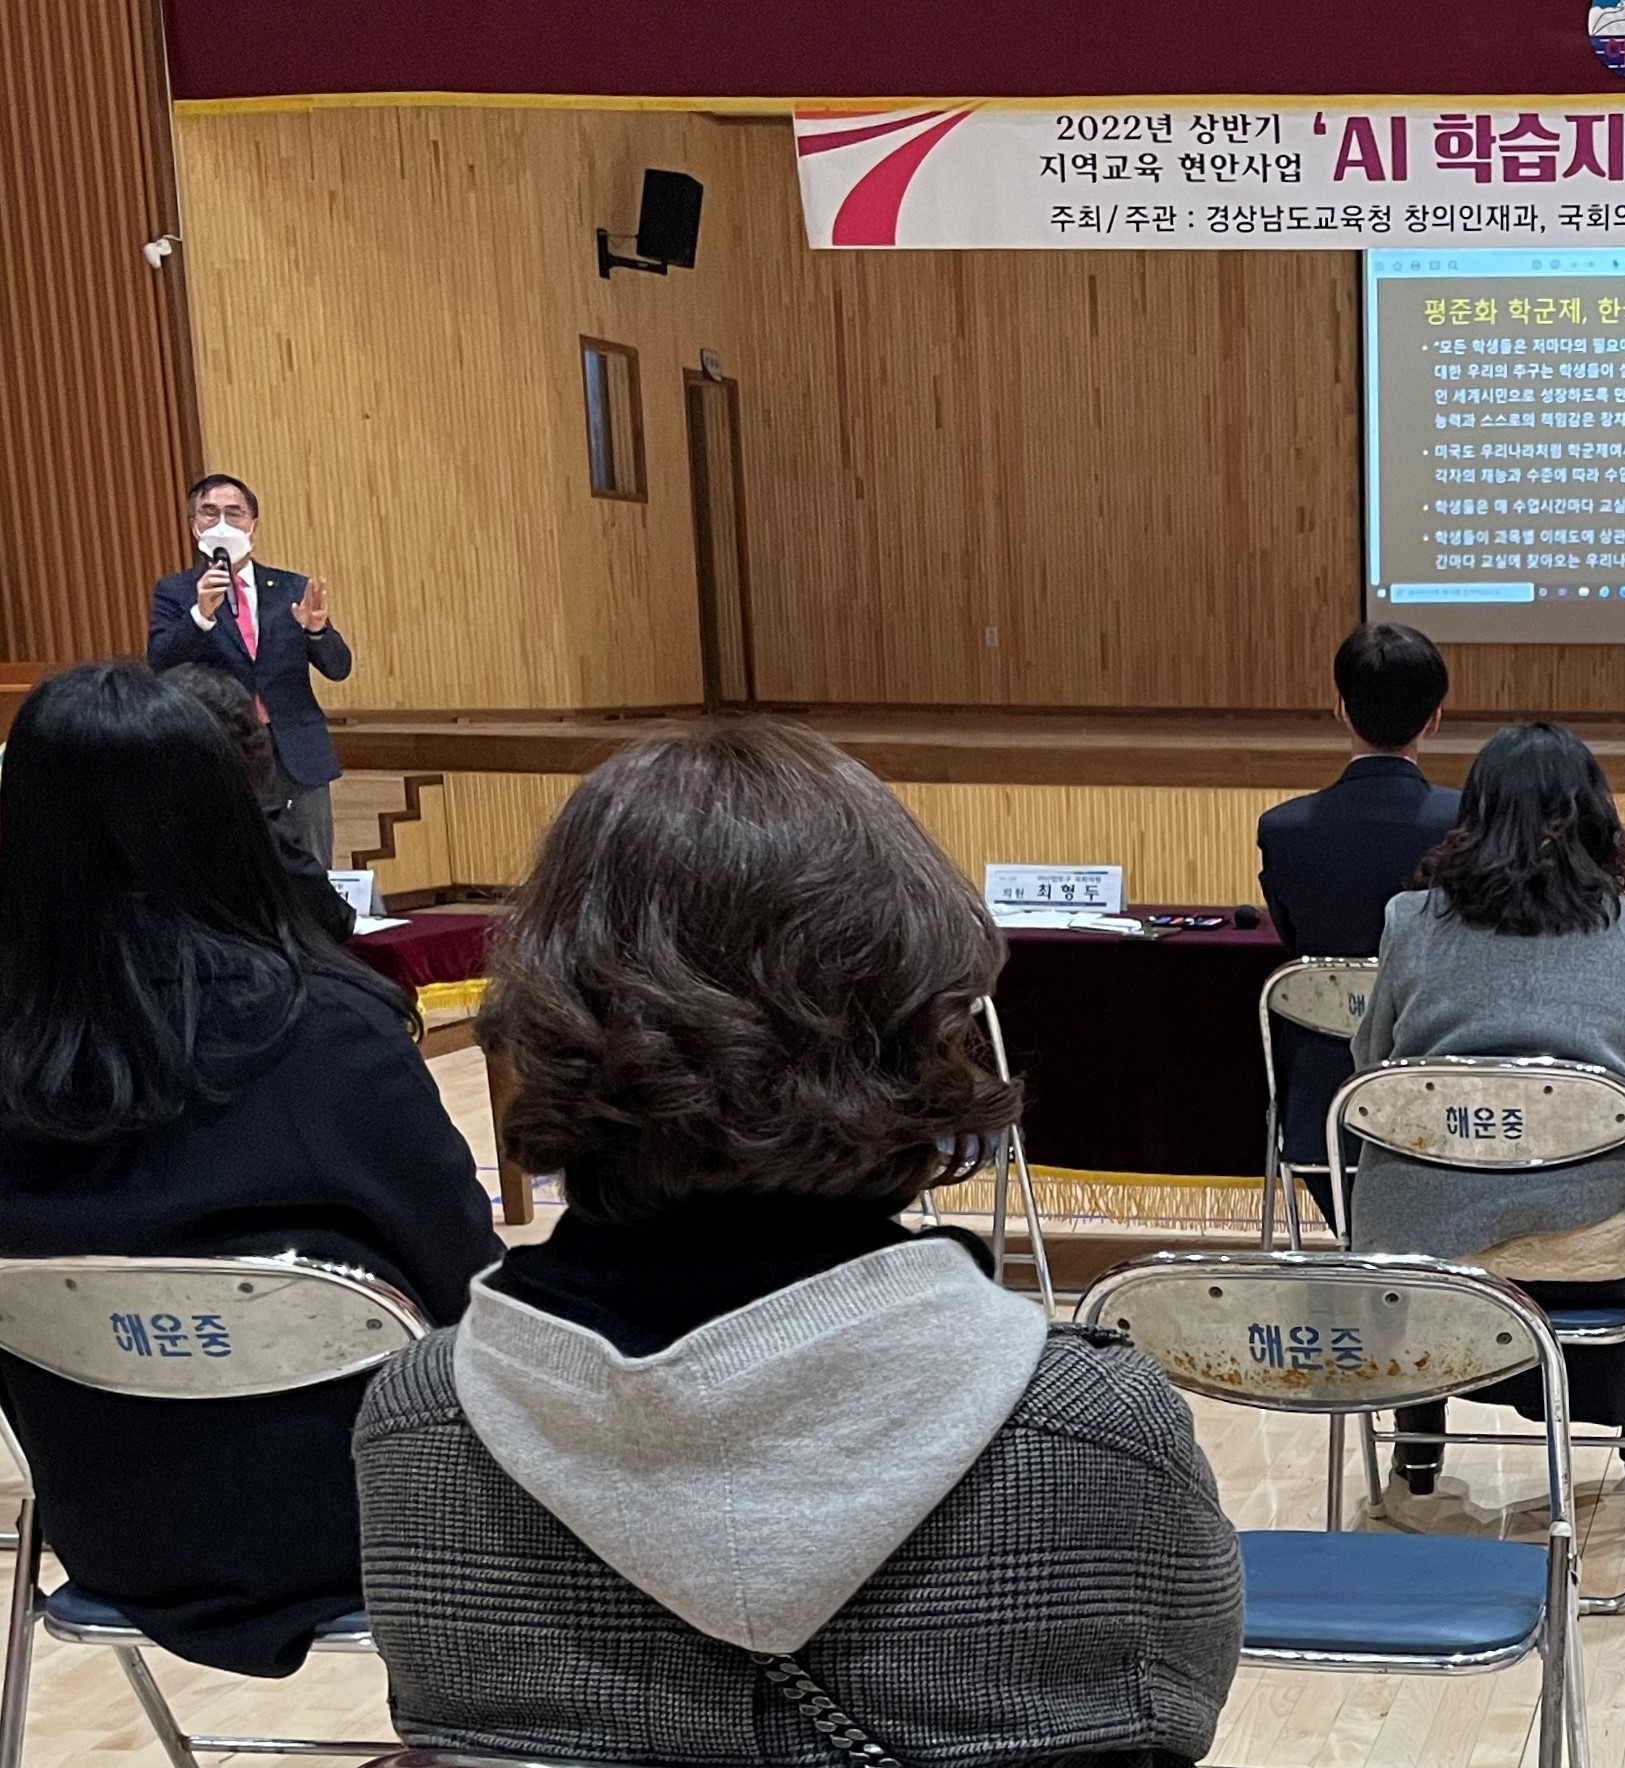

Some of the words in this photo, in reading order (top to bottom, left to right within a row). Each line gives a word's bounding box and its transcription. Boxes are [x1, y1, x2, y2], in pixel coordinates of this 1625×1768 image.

[1057, 114, 1172, 143] 2022년
[1189, 114, 1280, 144] 상반기
[1040, 153, 1163, 183] 지역교육
[1178, 153, 1300, 183] 현안사업
[1207, 205, 1390, 233] 경상남도교육청
[1405, 205, 1545, 233] 창의인재과,
[1424, 298, 1497, 325] 평준화
[1508, 298, 1587, 325] 학군제,
[1532, 338, 1586, 354] 저마다의
[1467, 363, 1507, 379] 우리의
[1513, 363, 1553, 379] 추구는
[1480, 412, 1535, 427] 스스로의
[1435, 444, 1475, 459] 미국도
[1037, 883, 1100, 901] 최형두
[1446, 1106, 1523, 1140] 해운중
[110, 1313, 233, 1358] 해운중
[1247, 1322, 1364, 1373] 해운중
